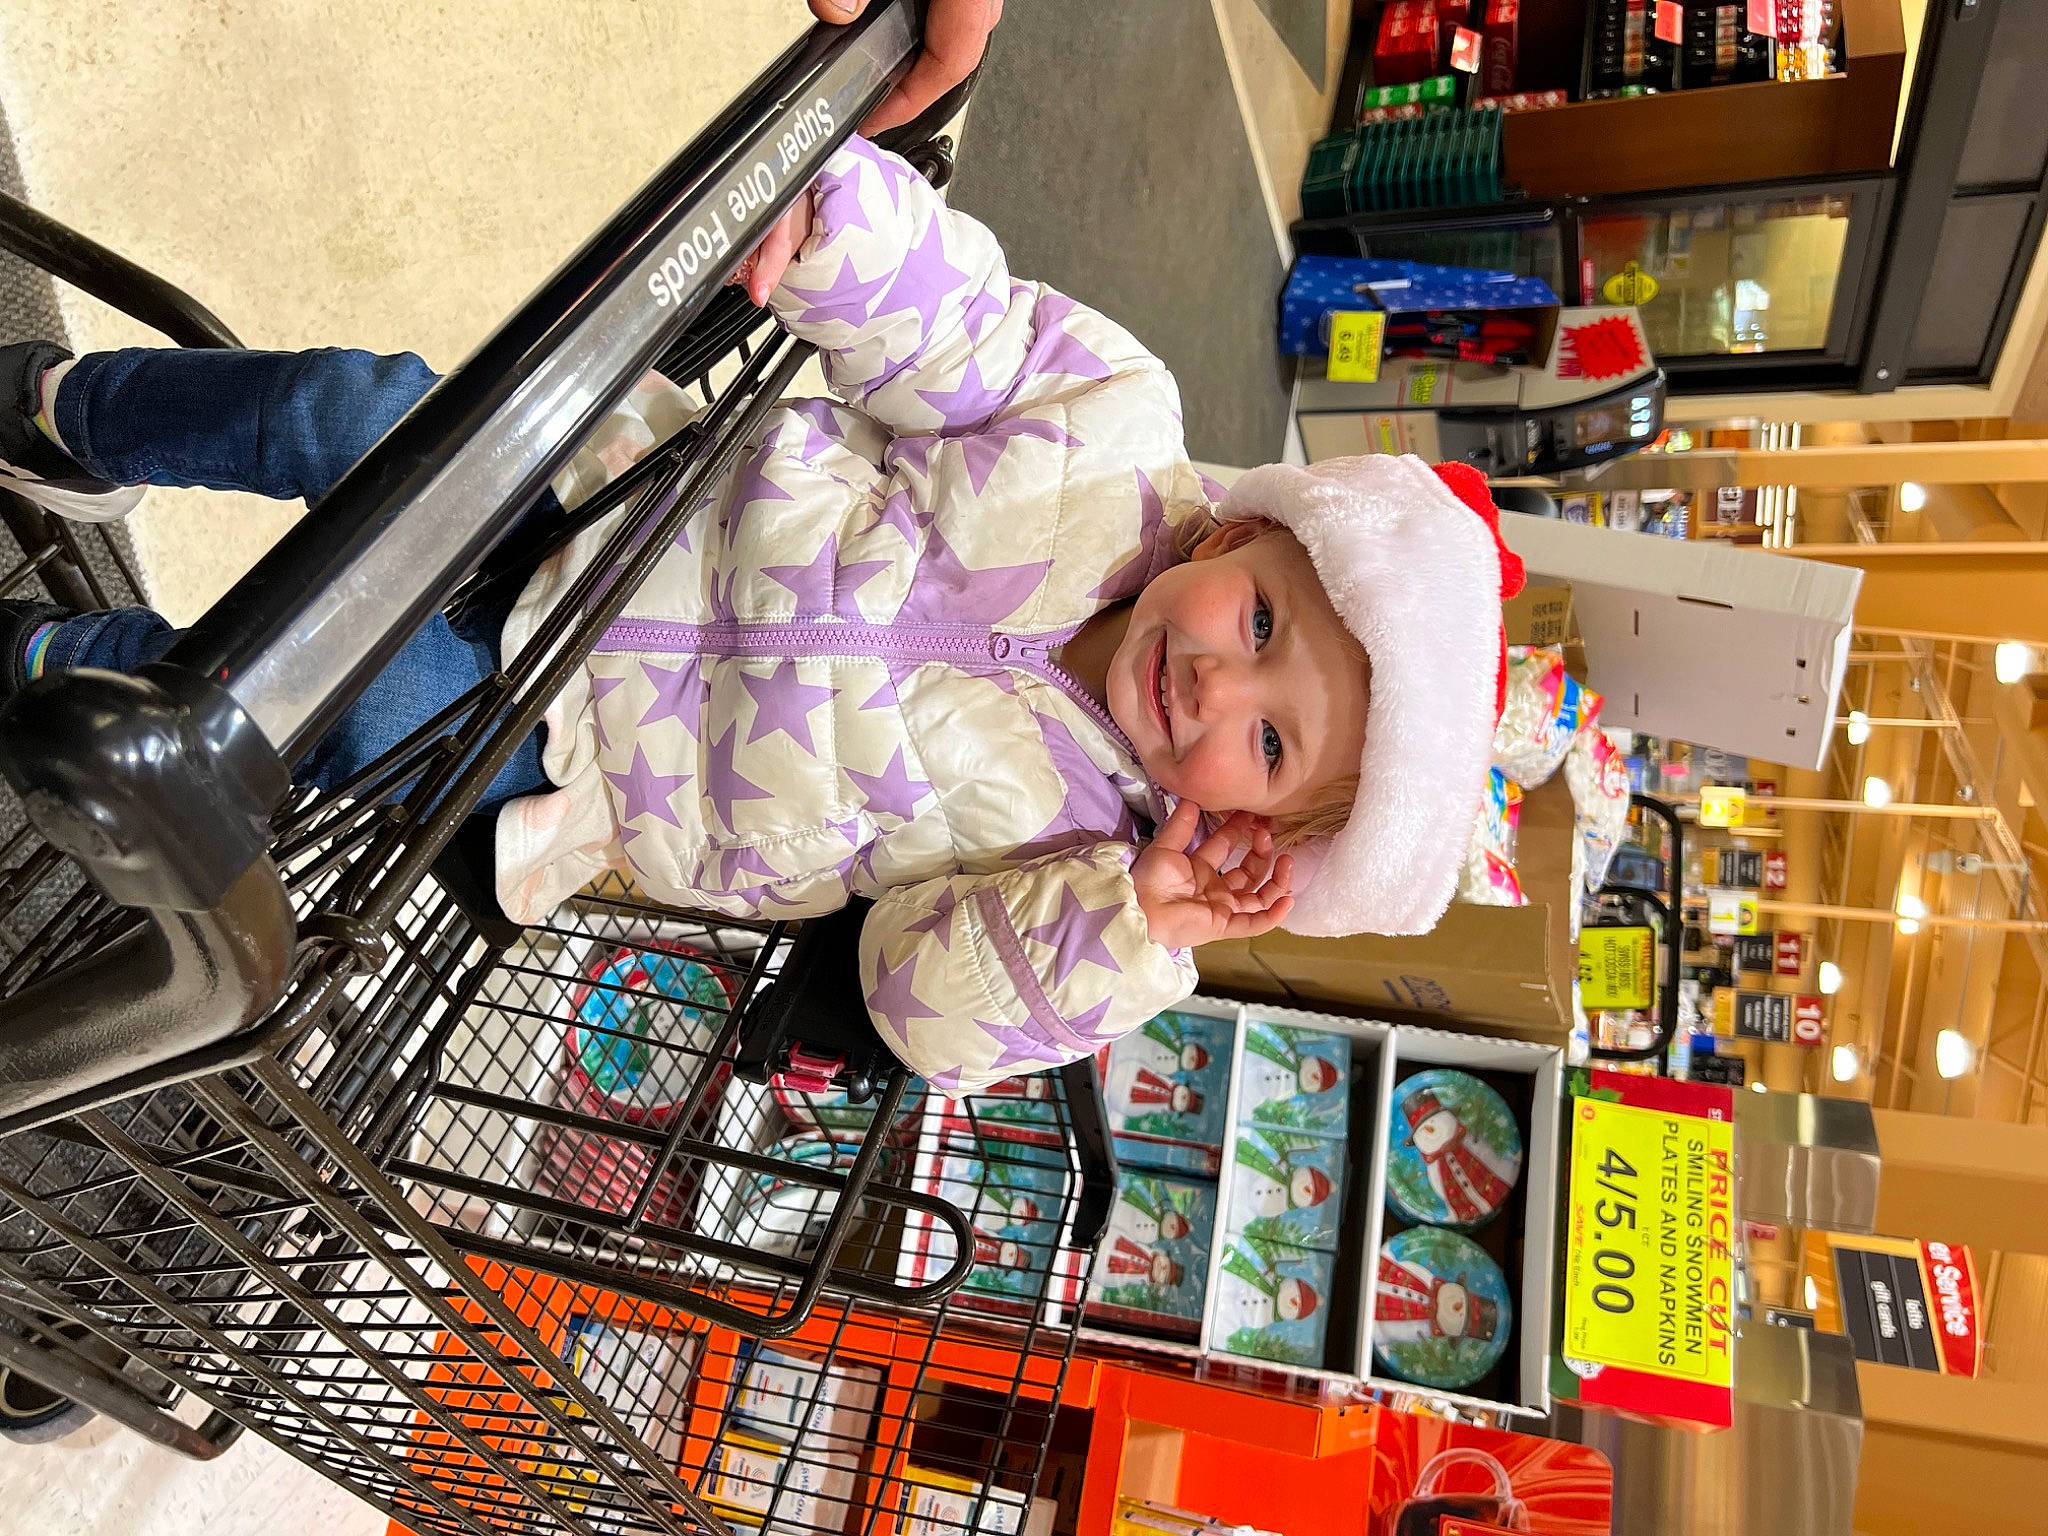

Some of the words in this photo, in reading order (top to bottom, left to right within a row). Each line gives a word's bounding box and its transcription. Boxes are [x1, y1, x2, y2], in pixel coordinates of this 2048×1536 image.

[776, 97, 835, 176] Super
[727, 162, 777, 223] One
[647, 209, 732, 307] Foods
[1765, 857, 1786, 887] 12
[1777, 940, 1800, 969] 11
[1794, 1004, 1821, 1040] 10
[1660, 1120, 1678, 1203] PLATES
[1686, 1139, 1703, 1227] SMILING
[1592, 1149, 1638, 1315] 4/5.00
[1660, 1210, 1677, 1257] AND
[1708, 1148, 1728, 1260] PRICE
[1658, 1264, 1676, 1366] NAPKINS
[1685, 1236, 1702, 1355] SNOWMEN
[1708, 1277, 1727, 1357] CUT
